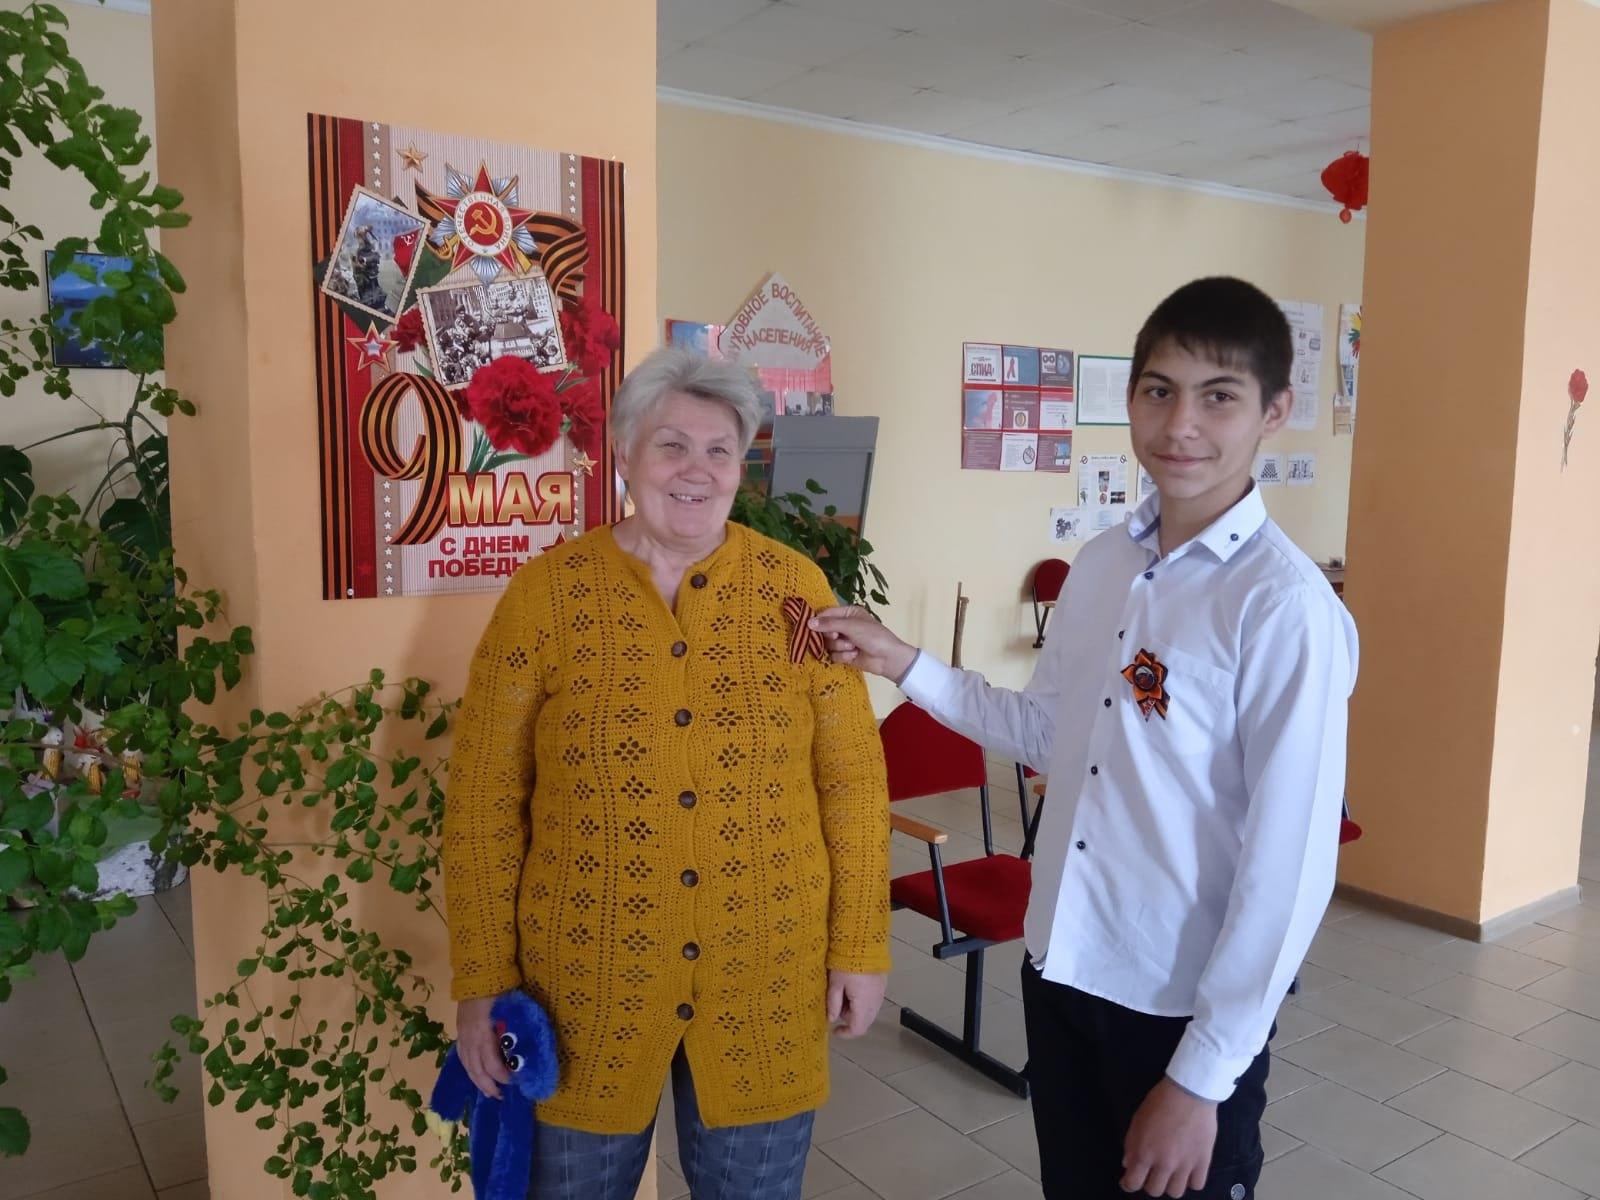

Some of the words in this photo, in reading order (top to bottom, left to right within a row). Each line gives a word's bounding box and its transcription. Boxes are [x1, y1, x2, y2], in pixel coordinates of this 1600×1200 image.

[743, 328, 812, 353] НАСЕЛЕНИЯ
[771, 283, 827, 358] ВОСПИТАНИЕ
[359, 372, 464, 544] 9
[447, 472, 574, 527] МАЯ
[440, 537, 456, 555] С
[463, 535, 529, 558] ДНЕМ
